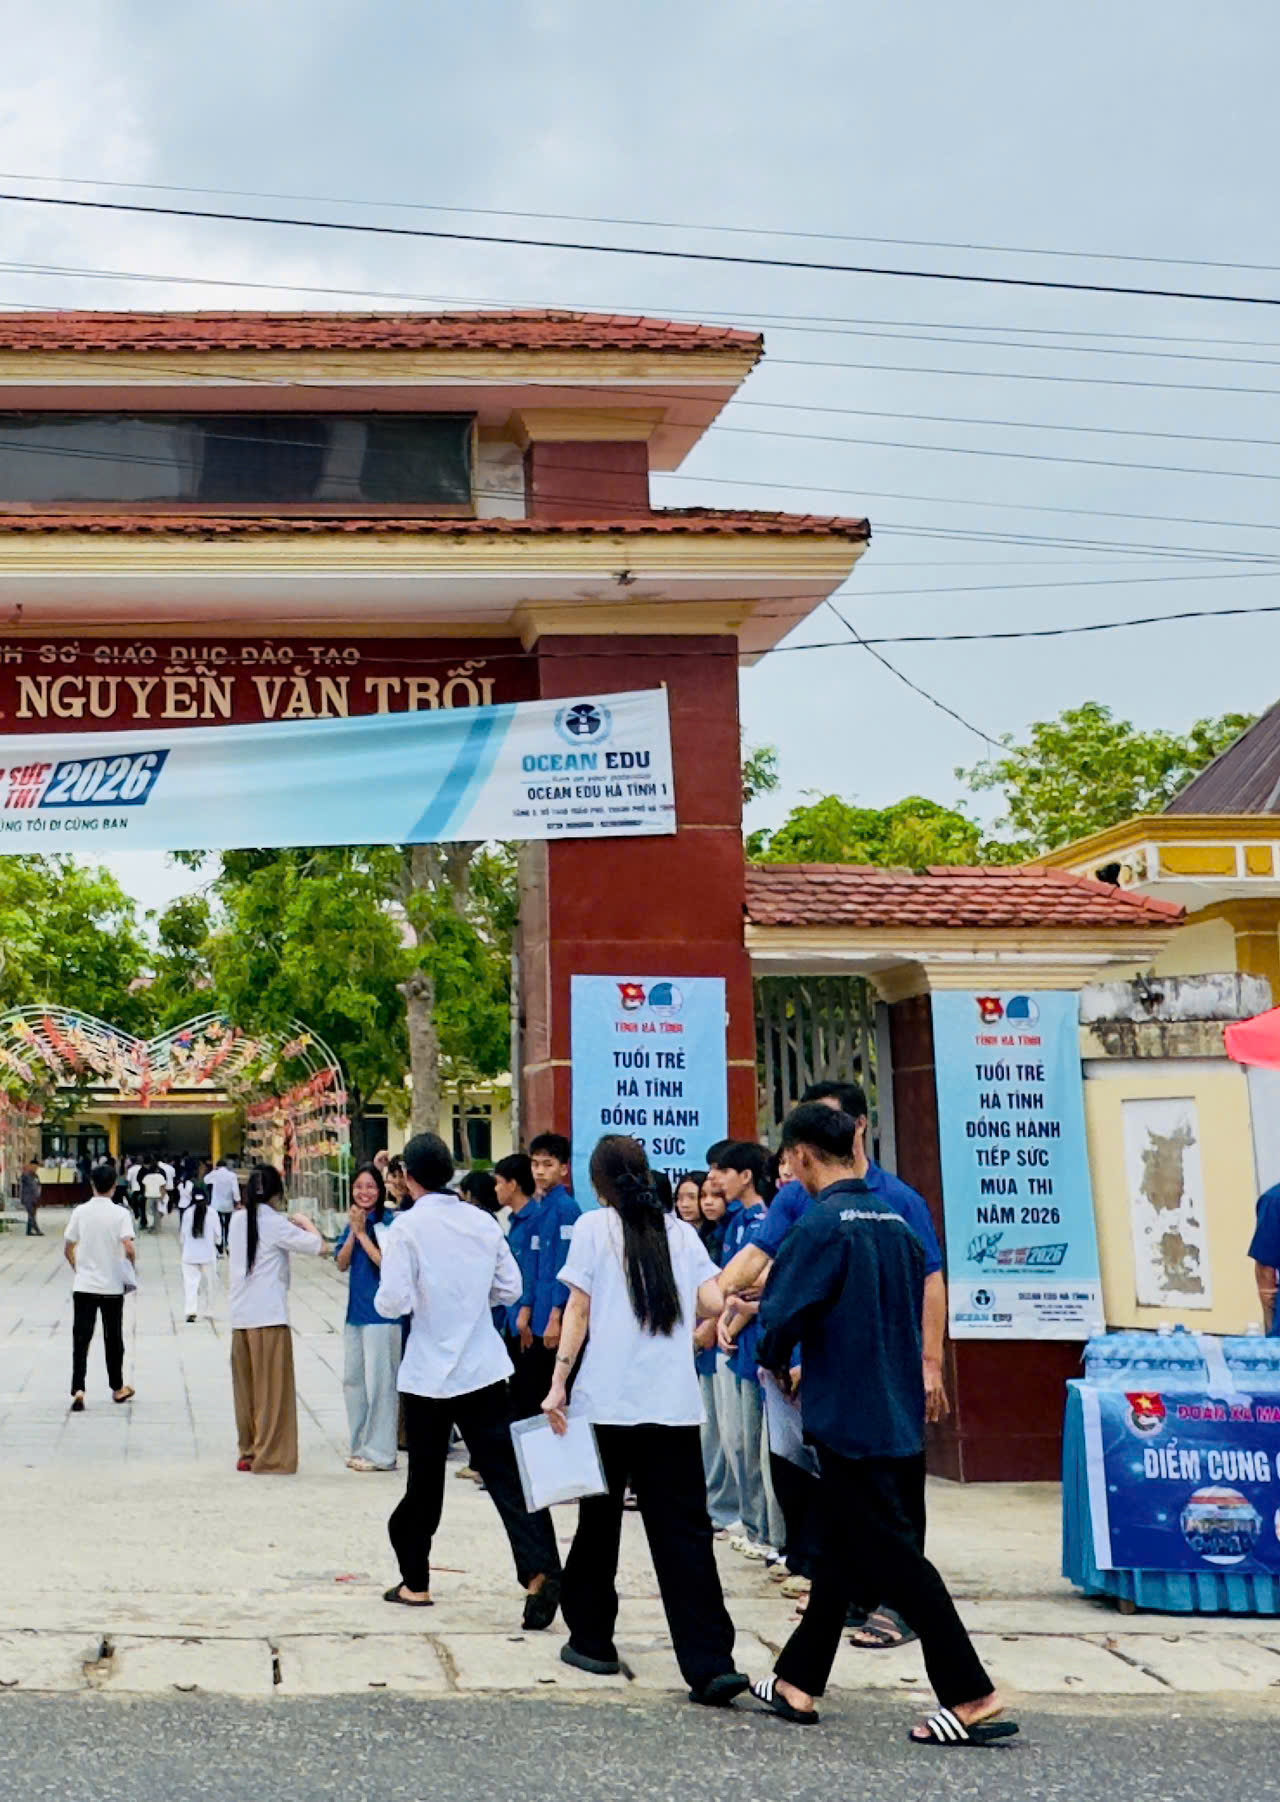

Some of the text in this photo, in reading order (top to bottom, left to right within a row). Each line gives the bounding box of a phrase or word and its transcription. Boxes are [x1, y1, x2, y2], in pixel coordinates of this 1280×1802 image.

[15, 664, 235, 719] NGUYỄN
[251, 666, 351, 718] VĂN
[364, 660, 496, 713] TRỖI
[522, 750, 650, 772] OCEAN EDU
[9, 761, 53, 787] SỨC
[45, 752, 158, 804] 2026
[4, 787, 42, 809] THI
[527, 785, 572, 800] OCEAN
[576, 784, 602, 799] EDU
[26, 818, 47, 832] TÔI
[64, 817, 99, 831] CÙNG
[613, 1045, 686, 1070] TUỔI TRẺ
[975, 1059, 1046, 1082] TUỔI TRẺ
[617, 1077, 683, 1098] HÀ TĨNH
[980, 1090, 1002, 1110] HÀ
[601, 1103, 699, 1127] ĐỒNG HÀNH
[966, 1116, 1061, 1138] ĐỒNG HÀNH
[652, 1134, 686, 1156] SỨC
[975, 1144, 1050, 1167] TIẾP SỨC
[980, 1174, 1053, 1196] MÙA THI
[976, 1204, 1060, 1225] NĂM 2026
[1028, 1245, 1063, 1264] 2026
[1207, 1449, 1272, 1483] CUNG
